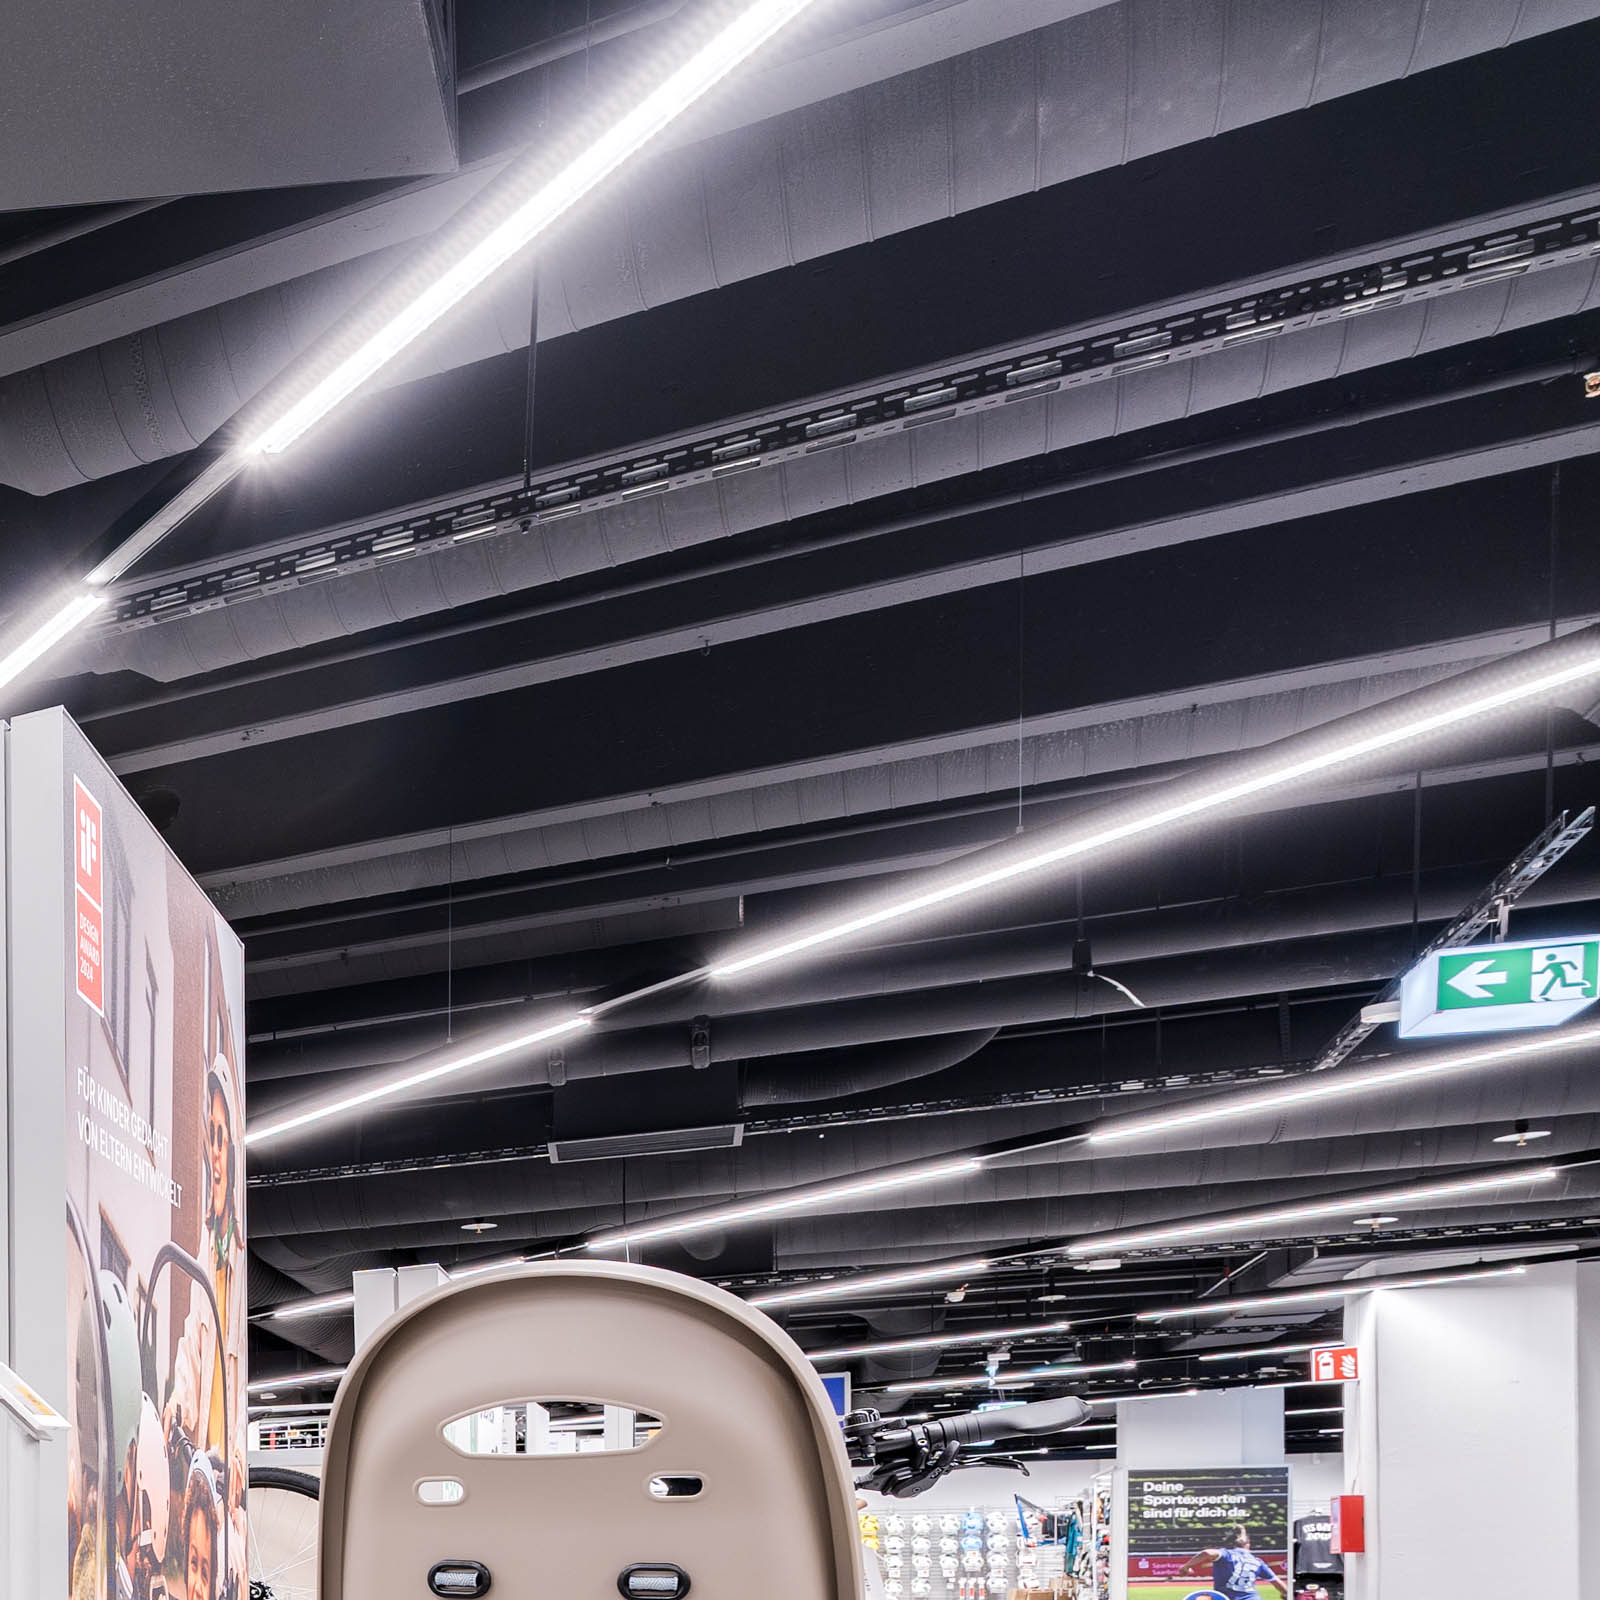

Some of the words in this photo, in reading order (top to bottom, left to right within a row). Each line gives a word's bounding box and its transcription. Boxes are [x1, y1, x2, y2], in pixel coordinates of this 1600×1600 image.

[79, 911, 99, 945] DESIGN
[79, 934, 99, 967] AWARD
[79, 956, 94, 984] 2024
[77, 1065, 96, 1107] FÜR
[97, 1083, 130, 1133] KINDER
[130, 1111, 169, 1161] GEDACHT
[77, 1111, 98, 1151] VON
[99, 1127, 133, 1174] ELTERN
[133, 1152, 183, 1208] ENTWICKELT
[1143, 1482, 1184, 1492] Deine
[1143, 1494, 1246, 1506] Sportexperten
[1143, 1508, 1173, 1518] sind
[1174, 1508, 1195, 1518] für
[1196, 1507, 1226, 1518] dich
[1228, 1507, 1250, 1518] da.
